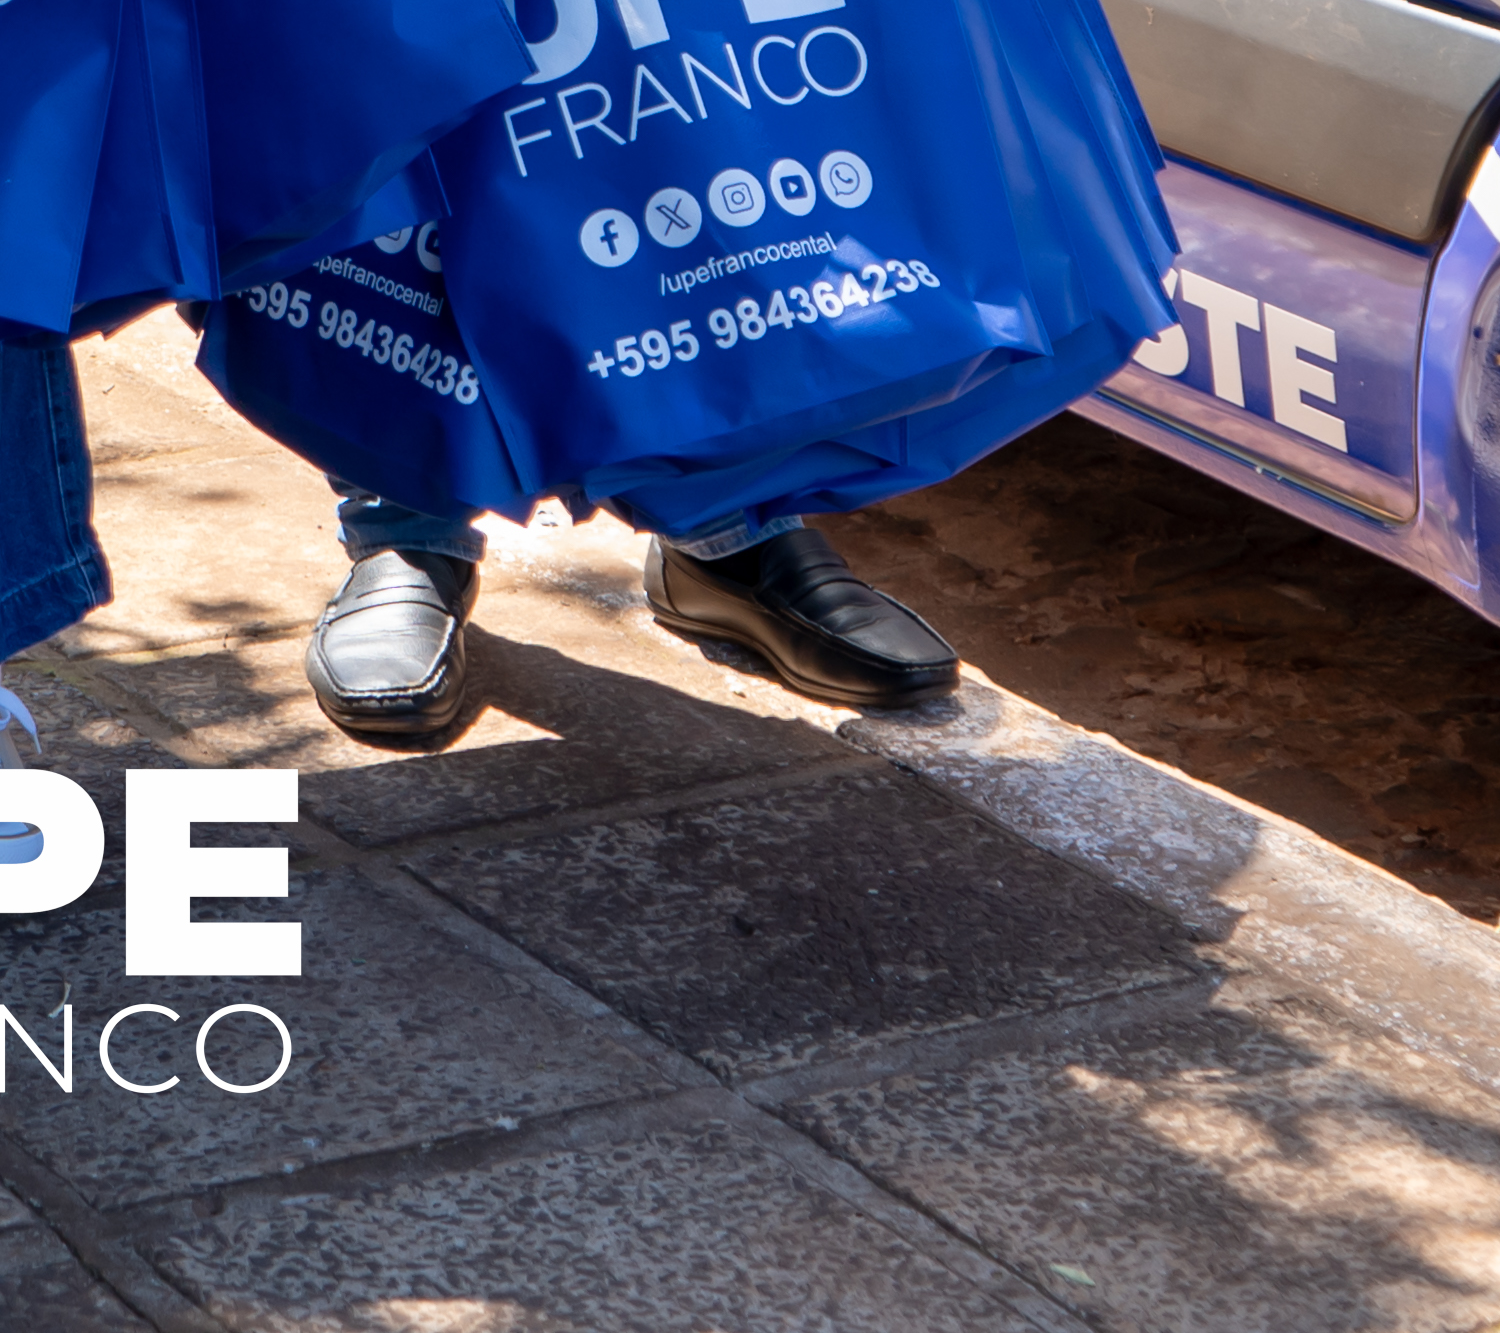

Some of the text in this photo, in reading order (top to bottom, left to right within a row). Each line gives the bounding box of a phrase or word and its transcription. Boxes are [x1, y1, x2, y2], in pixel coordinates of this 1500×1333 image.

[504, 25, 869, 178] FRANCO
[313, 255, 444, 317] pefrancocental
[659, 231, 838, 297] /upefrancocental
[318, 300, 480, 406] 984364238
[587, 258, 942, 380] +595 984364238
